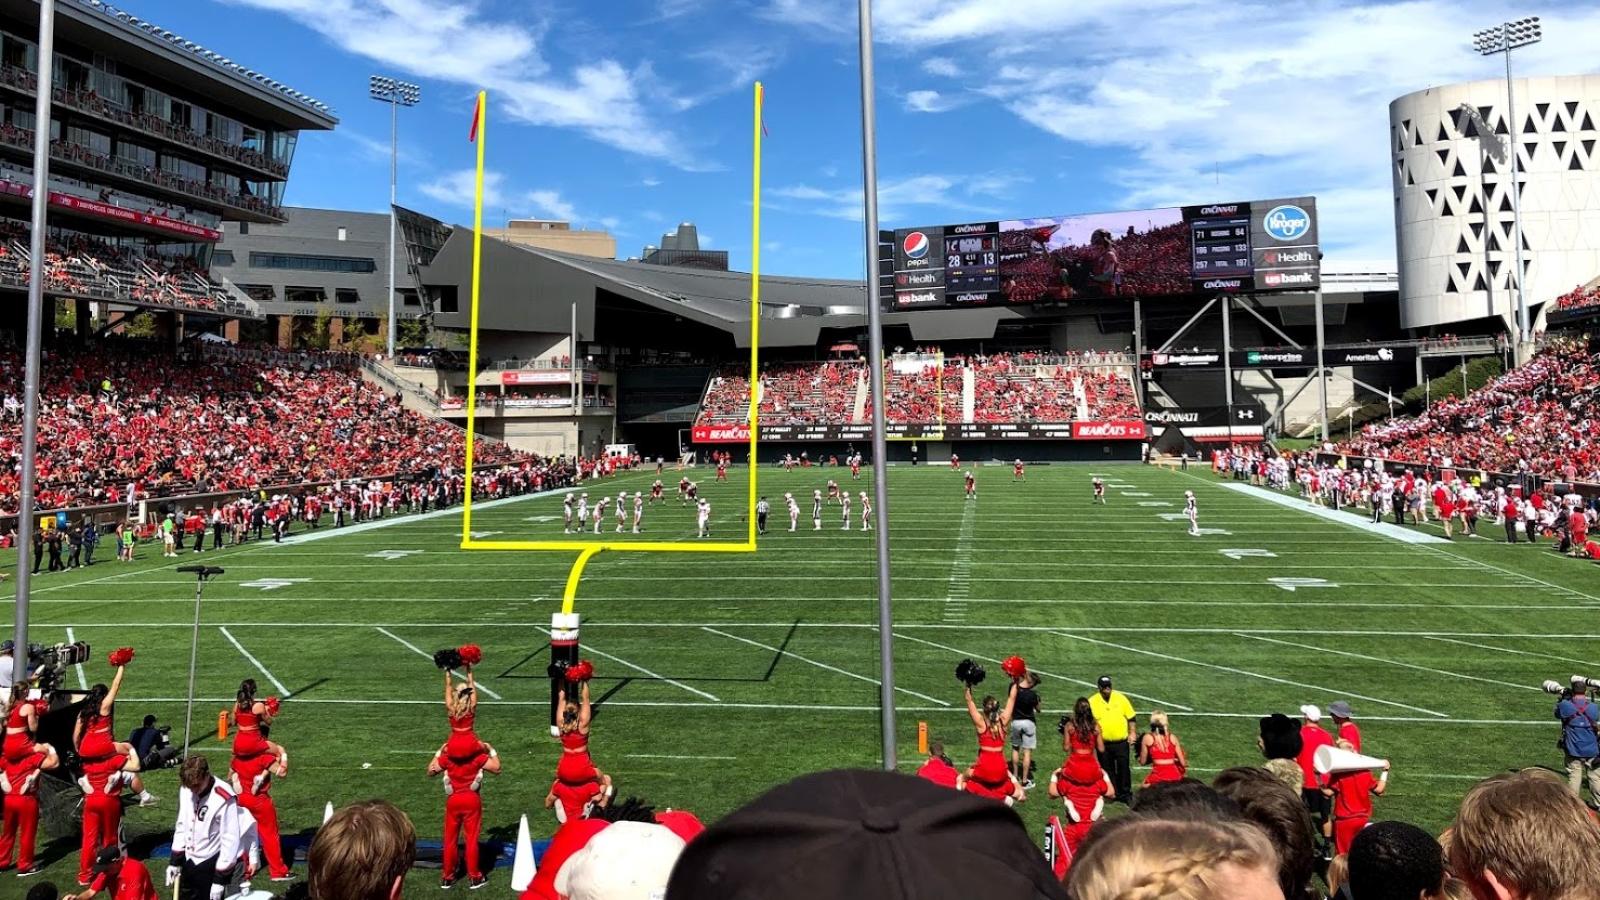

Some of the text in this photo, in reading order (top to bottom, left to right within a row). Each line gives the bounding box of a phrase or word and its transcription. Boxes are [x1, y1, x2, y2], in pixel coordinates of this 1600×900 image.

[1201, 205, 1238, 215] CINCINNATI
[955, 224, 986, 233] CINCINNATI
[1270, 212, 1305, 236] Kroger
[948, 255, 960, 267] 28
[983, 253, 994, 265] 13
[1277, 251, 1312, 262] Health
[907, 258, 929, 267] pepsi
[909, 274, 935, 284] Health
[1203, 280, 1241, 289] CINCINNATI
[956, 293, 988, 301] CINCINNATI
[1345, 353, 1380, 362] Ameritas
[1078, 423, 1126, 436] BEARCATS
